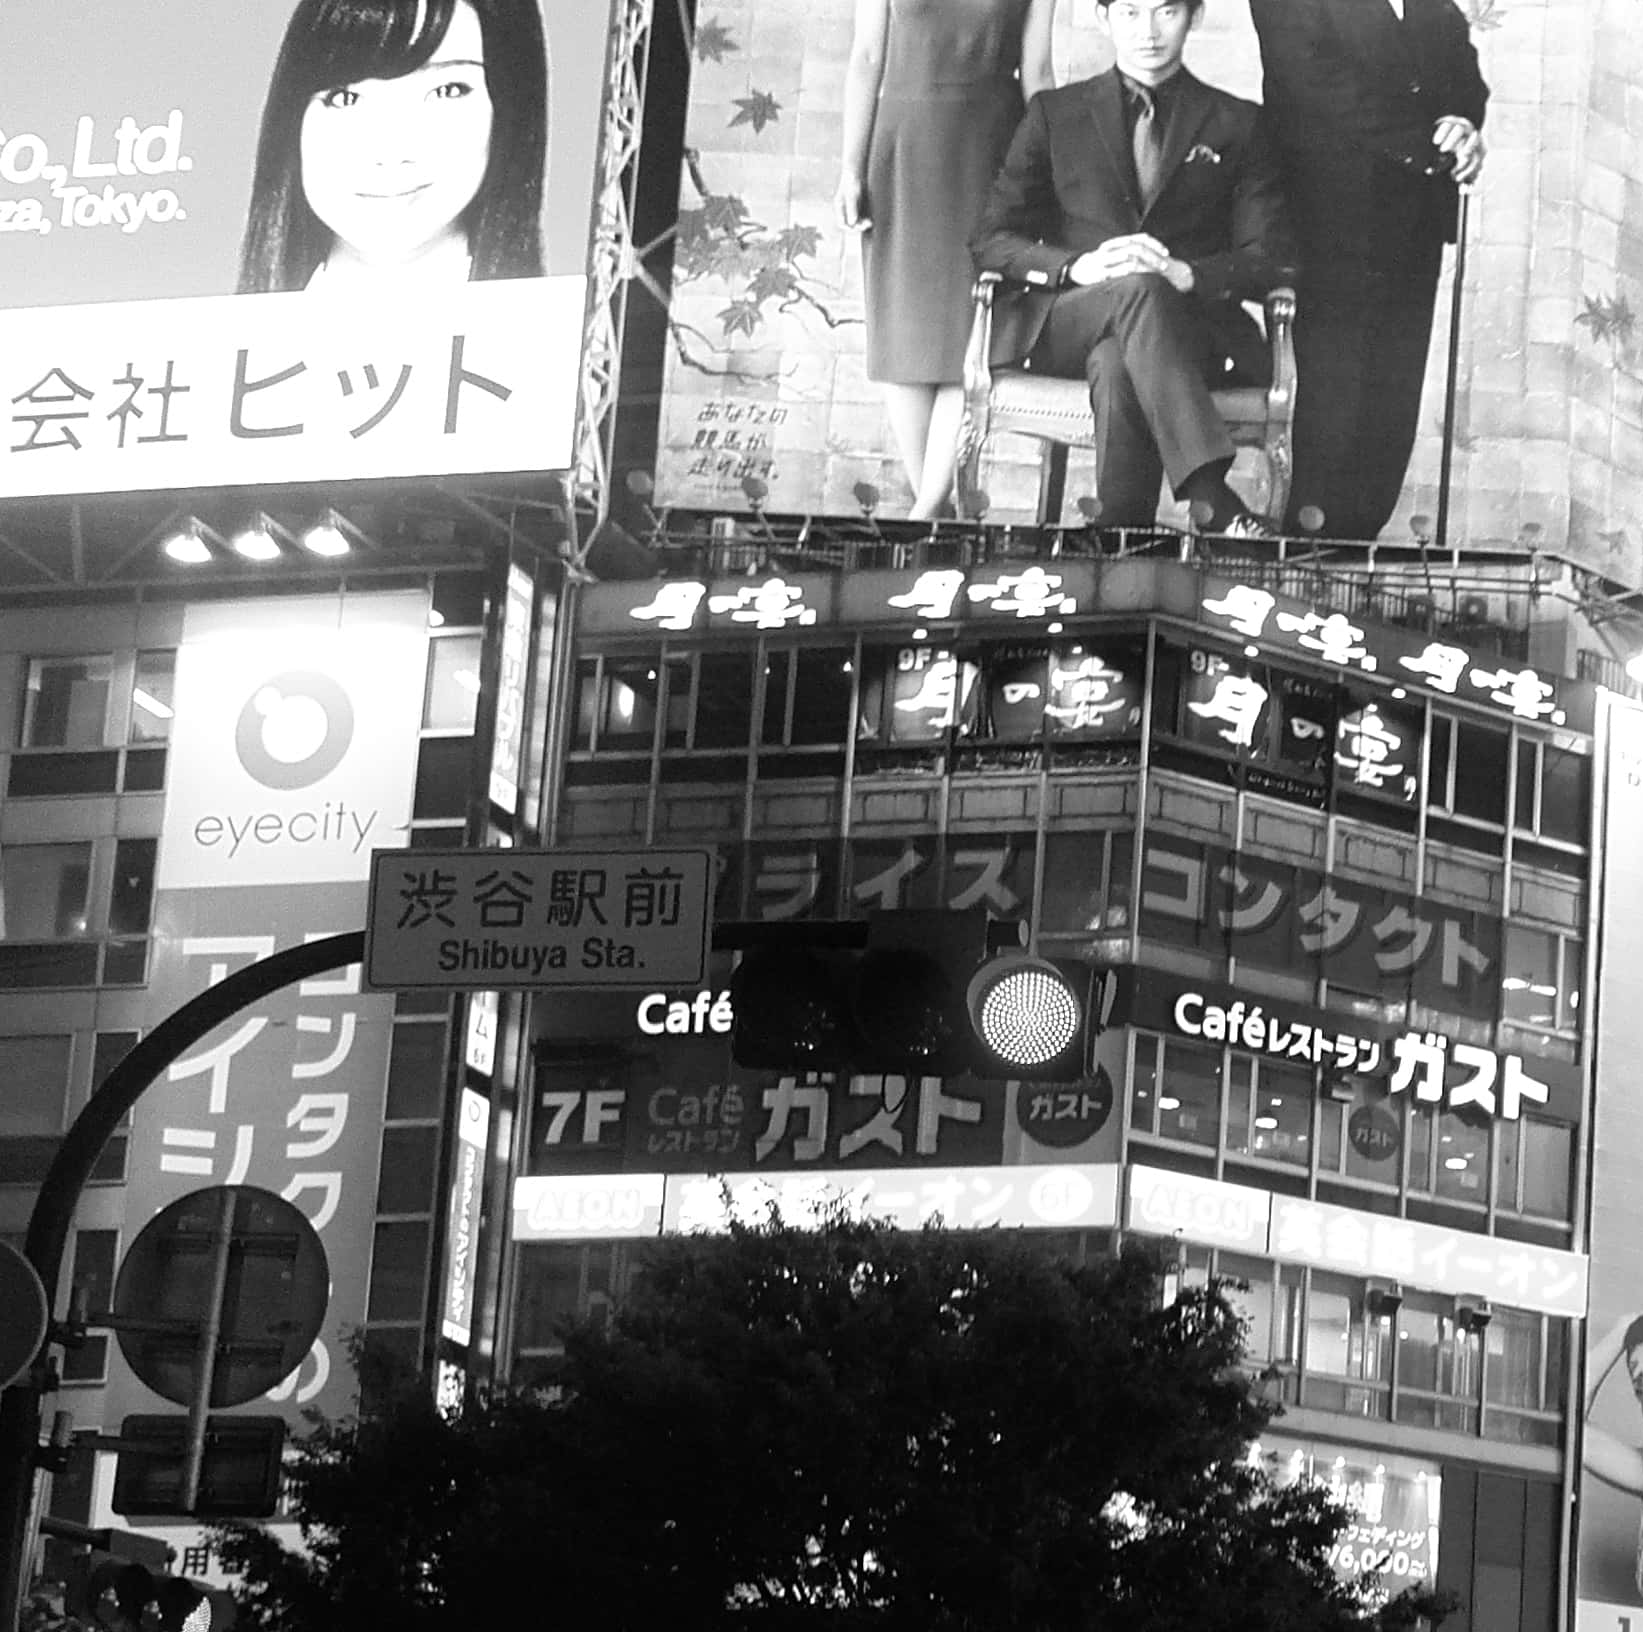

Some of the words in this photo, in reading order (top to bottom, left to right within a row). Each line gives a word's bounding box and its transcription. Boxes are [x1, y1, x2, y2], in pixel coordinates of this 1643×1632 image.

[0, 108, 193, 190] o.,Ltd.
[52, 184, 187, 233] Tokyo.
[193, 802, 379, 858] eyecity
[397, 869, 684, 930] 渋谷駅前
[1143, 847, 1491, 990] コンタクト
[437, 937, 568, 974] Shibuya
[580, 938, 647, 971] Sta.
[636, 993, 734, 1035] Café
[1174, 993, 1268, 1049] Café
[1268, 1019, 1382, 1073] レストラン
[1389, 1032, 1551, 1122] ガスト
[541, 1089, 627, 1146] 7F
[647, 1085, 746, 1128] Café
[756, 1071, 983, 1163] ガスト
[1029, 1093, 1103, 1121] ガスト
[1354, 1124, 1396, 1149] ガスト
[533, 1187, 642, 1228] AEON
[1144, 1183, 1254, 1236] AEON
